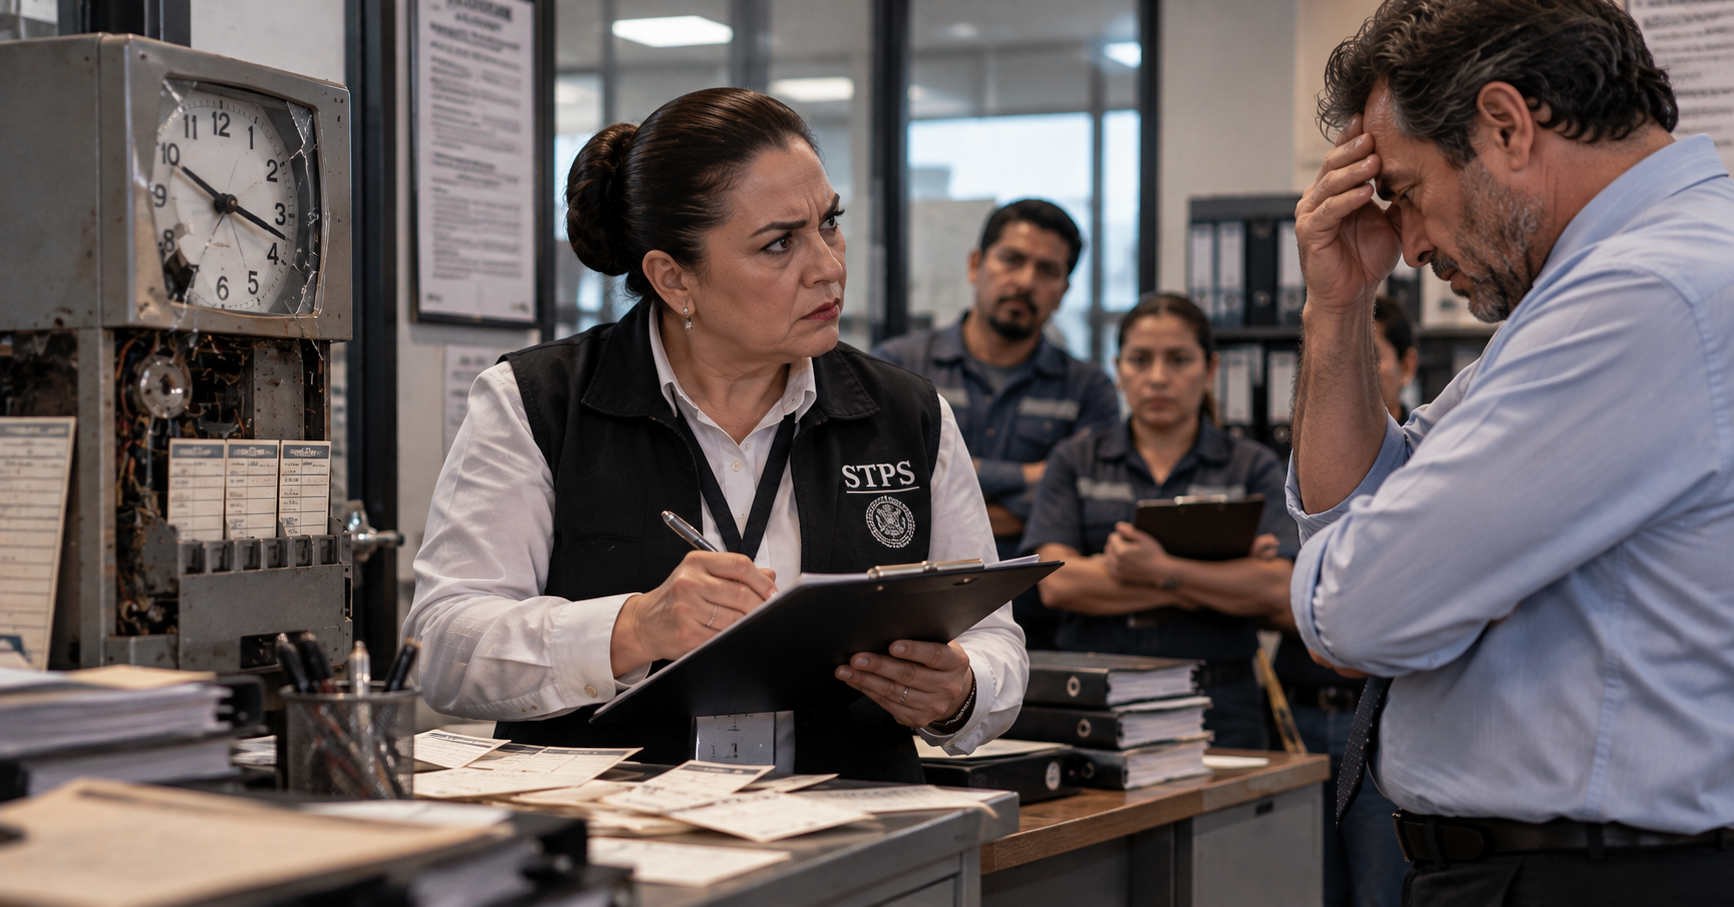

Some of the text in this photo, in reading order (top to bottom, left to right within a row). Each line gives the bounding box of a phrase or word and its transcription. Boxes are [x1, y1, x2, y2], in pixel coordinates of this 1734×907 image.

[183, 114, 198, 140] 11
[212, 111, 231, 137] 12
[247, 125, 255, 150] 1
[161, 142, 180, 166] 10
[266, 159, 278, 182] 2
[154, 184, 167, 208] 9
[275, 202, 286, 226] 3
[163, 229, 175, 252] 8
[267, 243, 279, 266] 4
[216, 276, 229, 301] 6
[248, 271, 259, 295] 5
[841, 460, 916, 488] STPS
